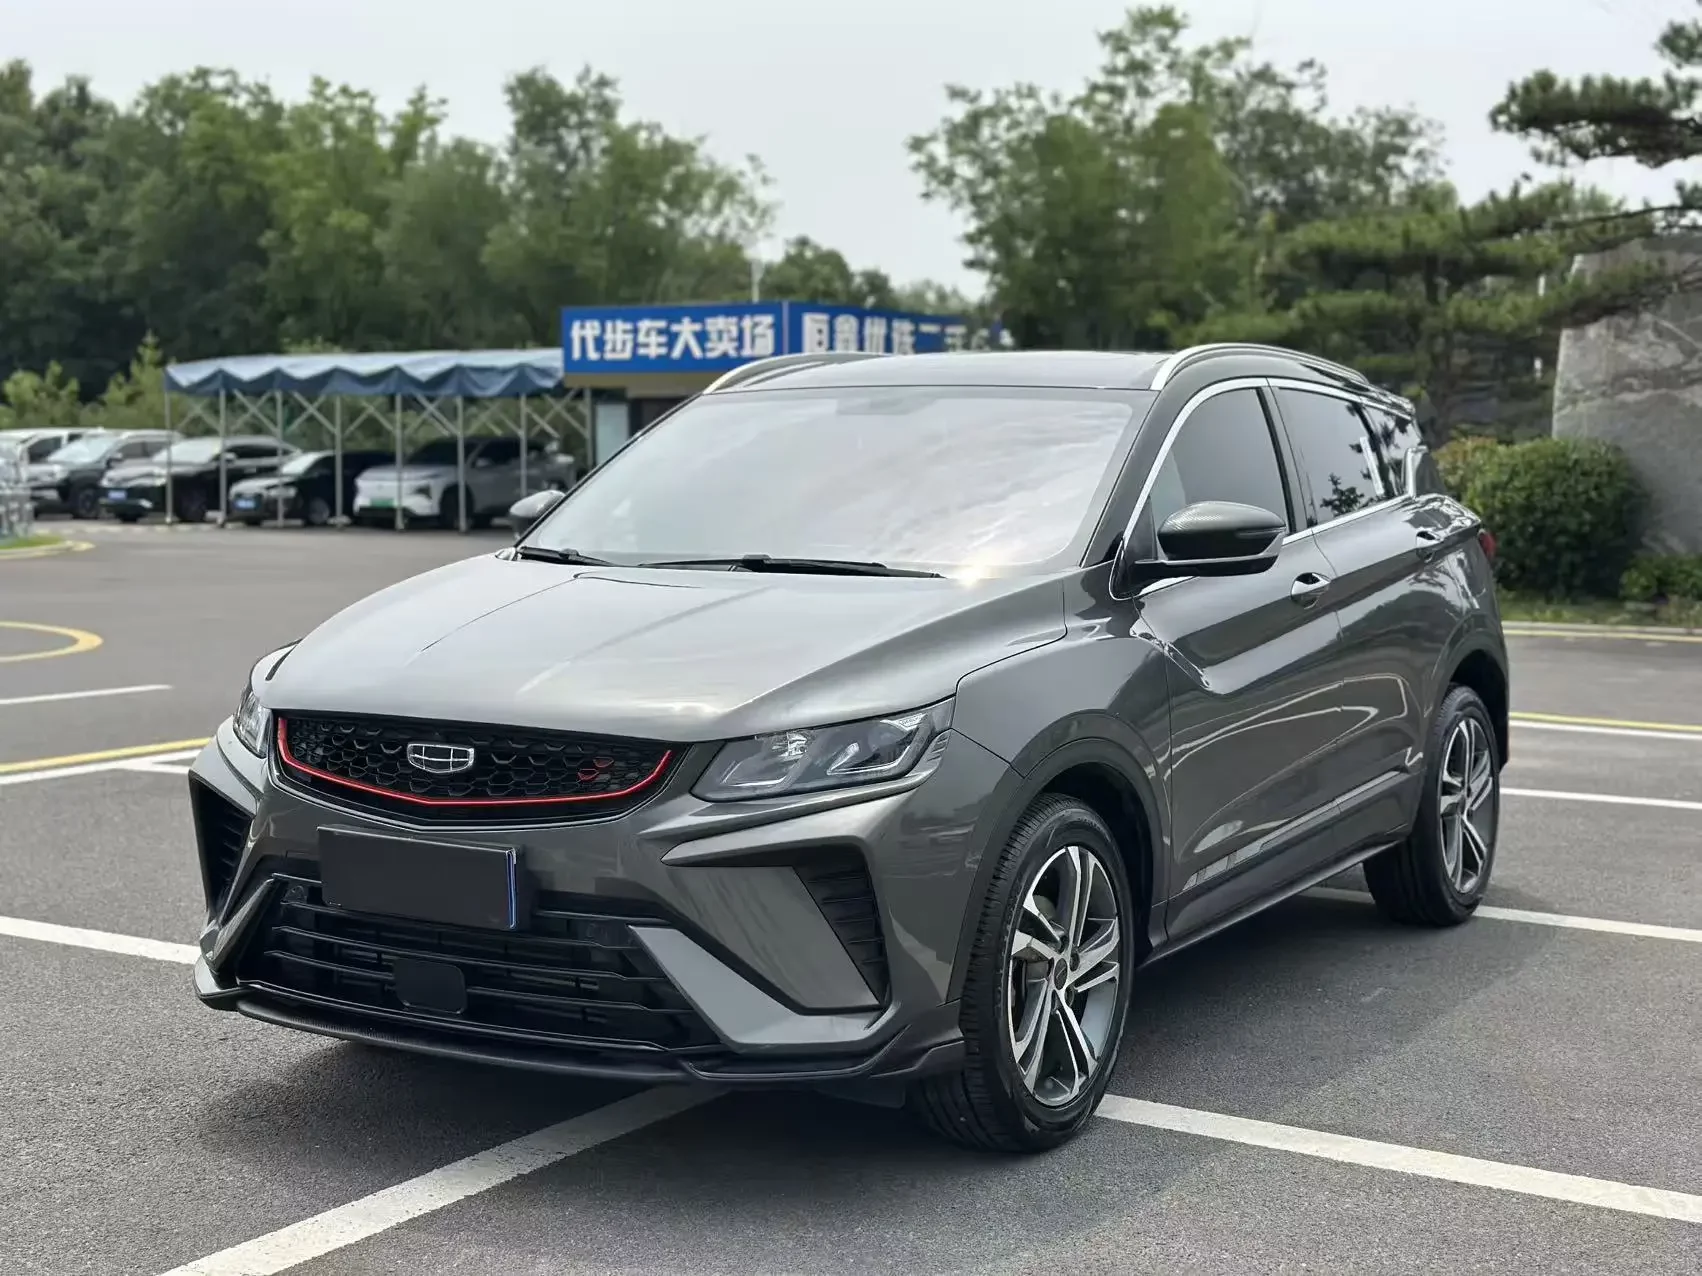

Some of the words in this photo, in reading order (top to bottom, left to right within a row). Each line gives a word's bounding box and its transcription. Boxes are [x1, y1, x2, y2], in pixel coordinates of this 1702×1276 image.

[571, 314, 775, 360] 代步车大卖场
